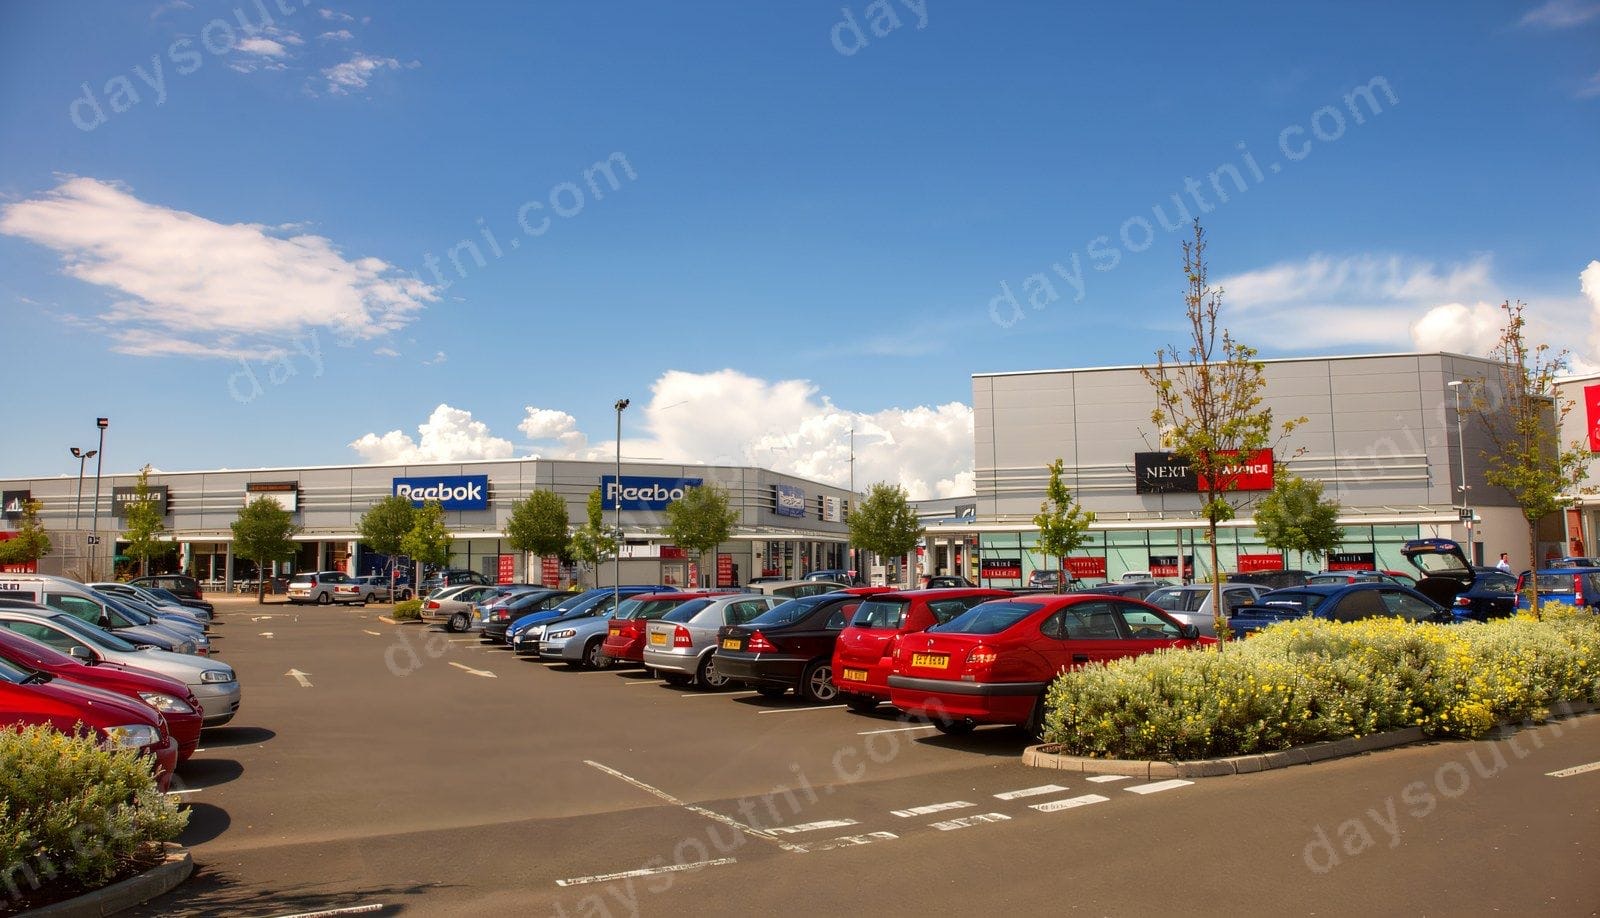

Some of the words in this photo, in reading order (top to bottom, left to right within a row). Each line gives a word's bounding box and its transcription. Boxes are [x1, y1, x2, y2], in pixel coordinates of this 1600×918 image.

[1146, 466, 1189, 478] NEXT
[396, 482, 482, 501] Reebok
[606, 482, 695, 501] Reebo
